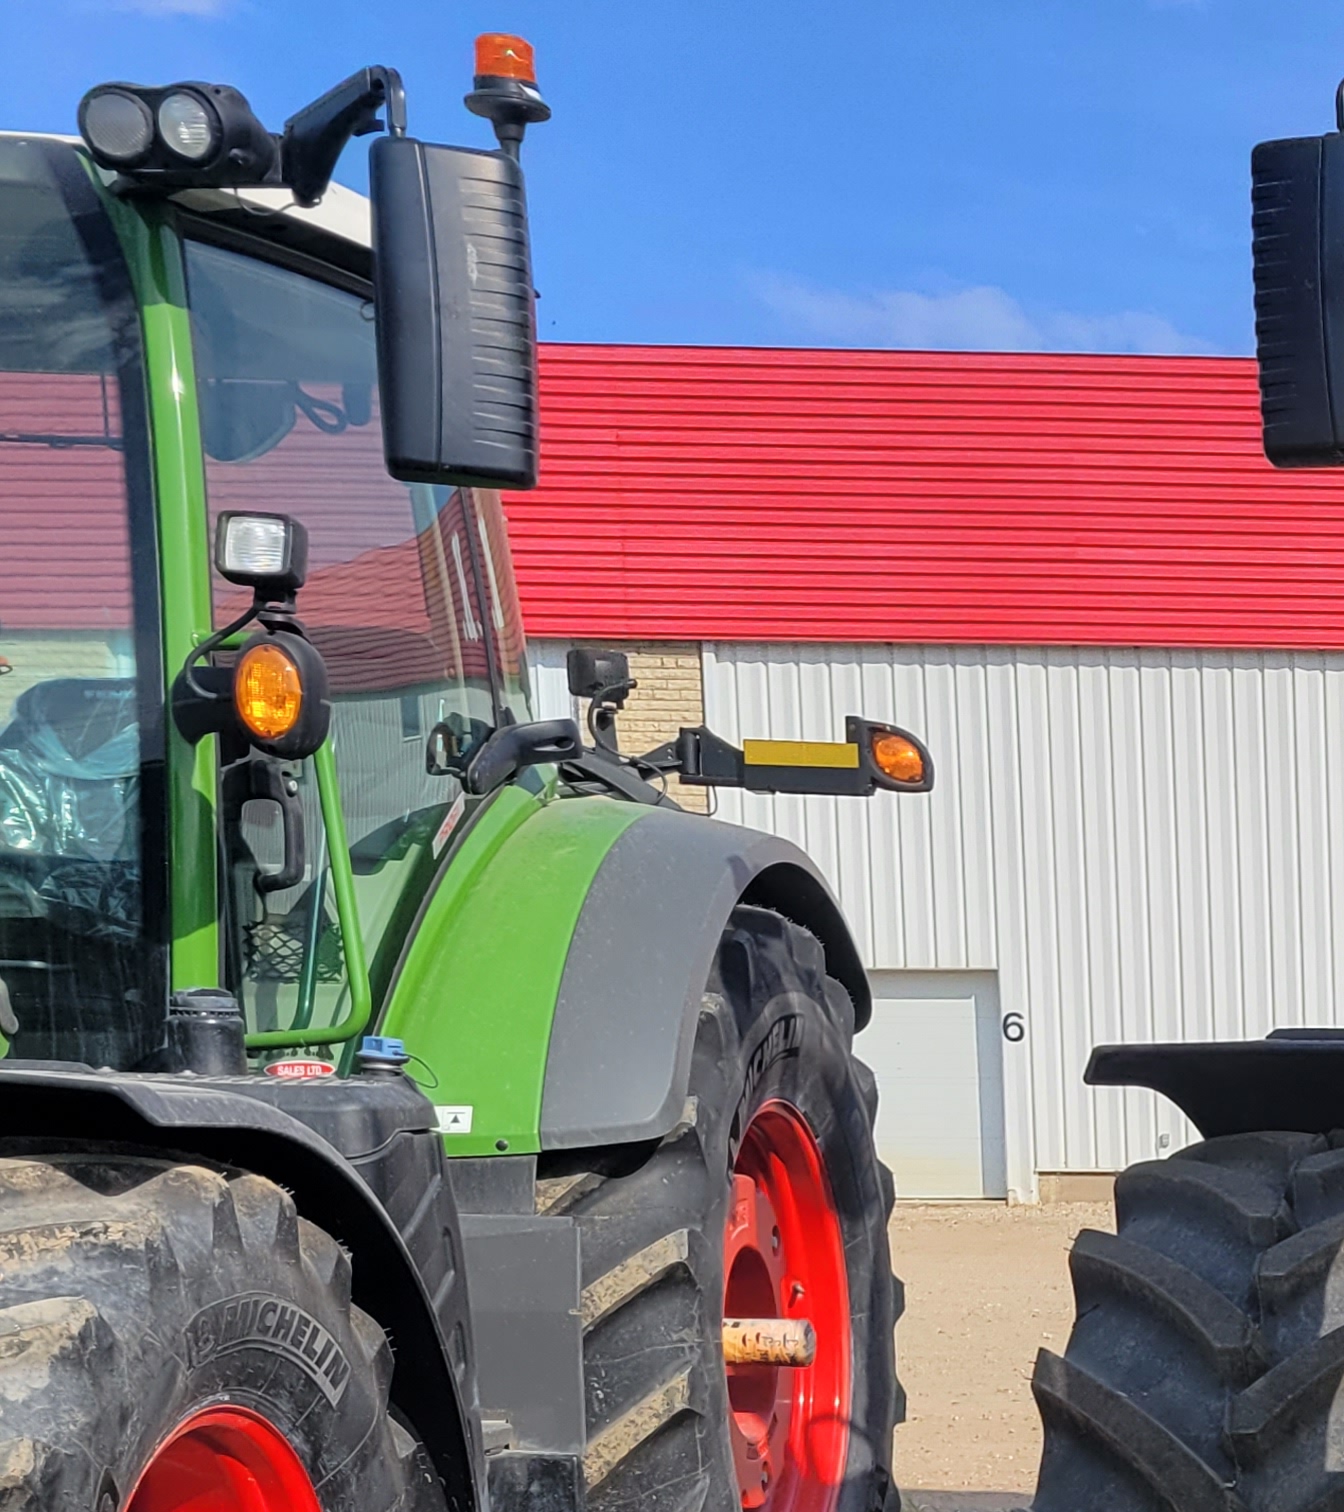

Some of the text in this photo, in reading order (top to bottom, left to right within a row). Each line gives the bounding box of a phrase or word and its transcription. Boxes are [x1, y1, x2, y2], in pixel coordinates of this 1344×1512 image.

[1002, 1011, 1025, 1042] 6
[277, 1065, 305, 1076] SALES
[220, 1297, 351, 1391] MICHELIN
